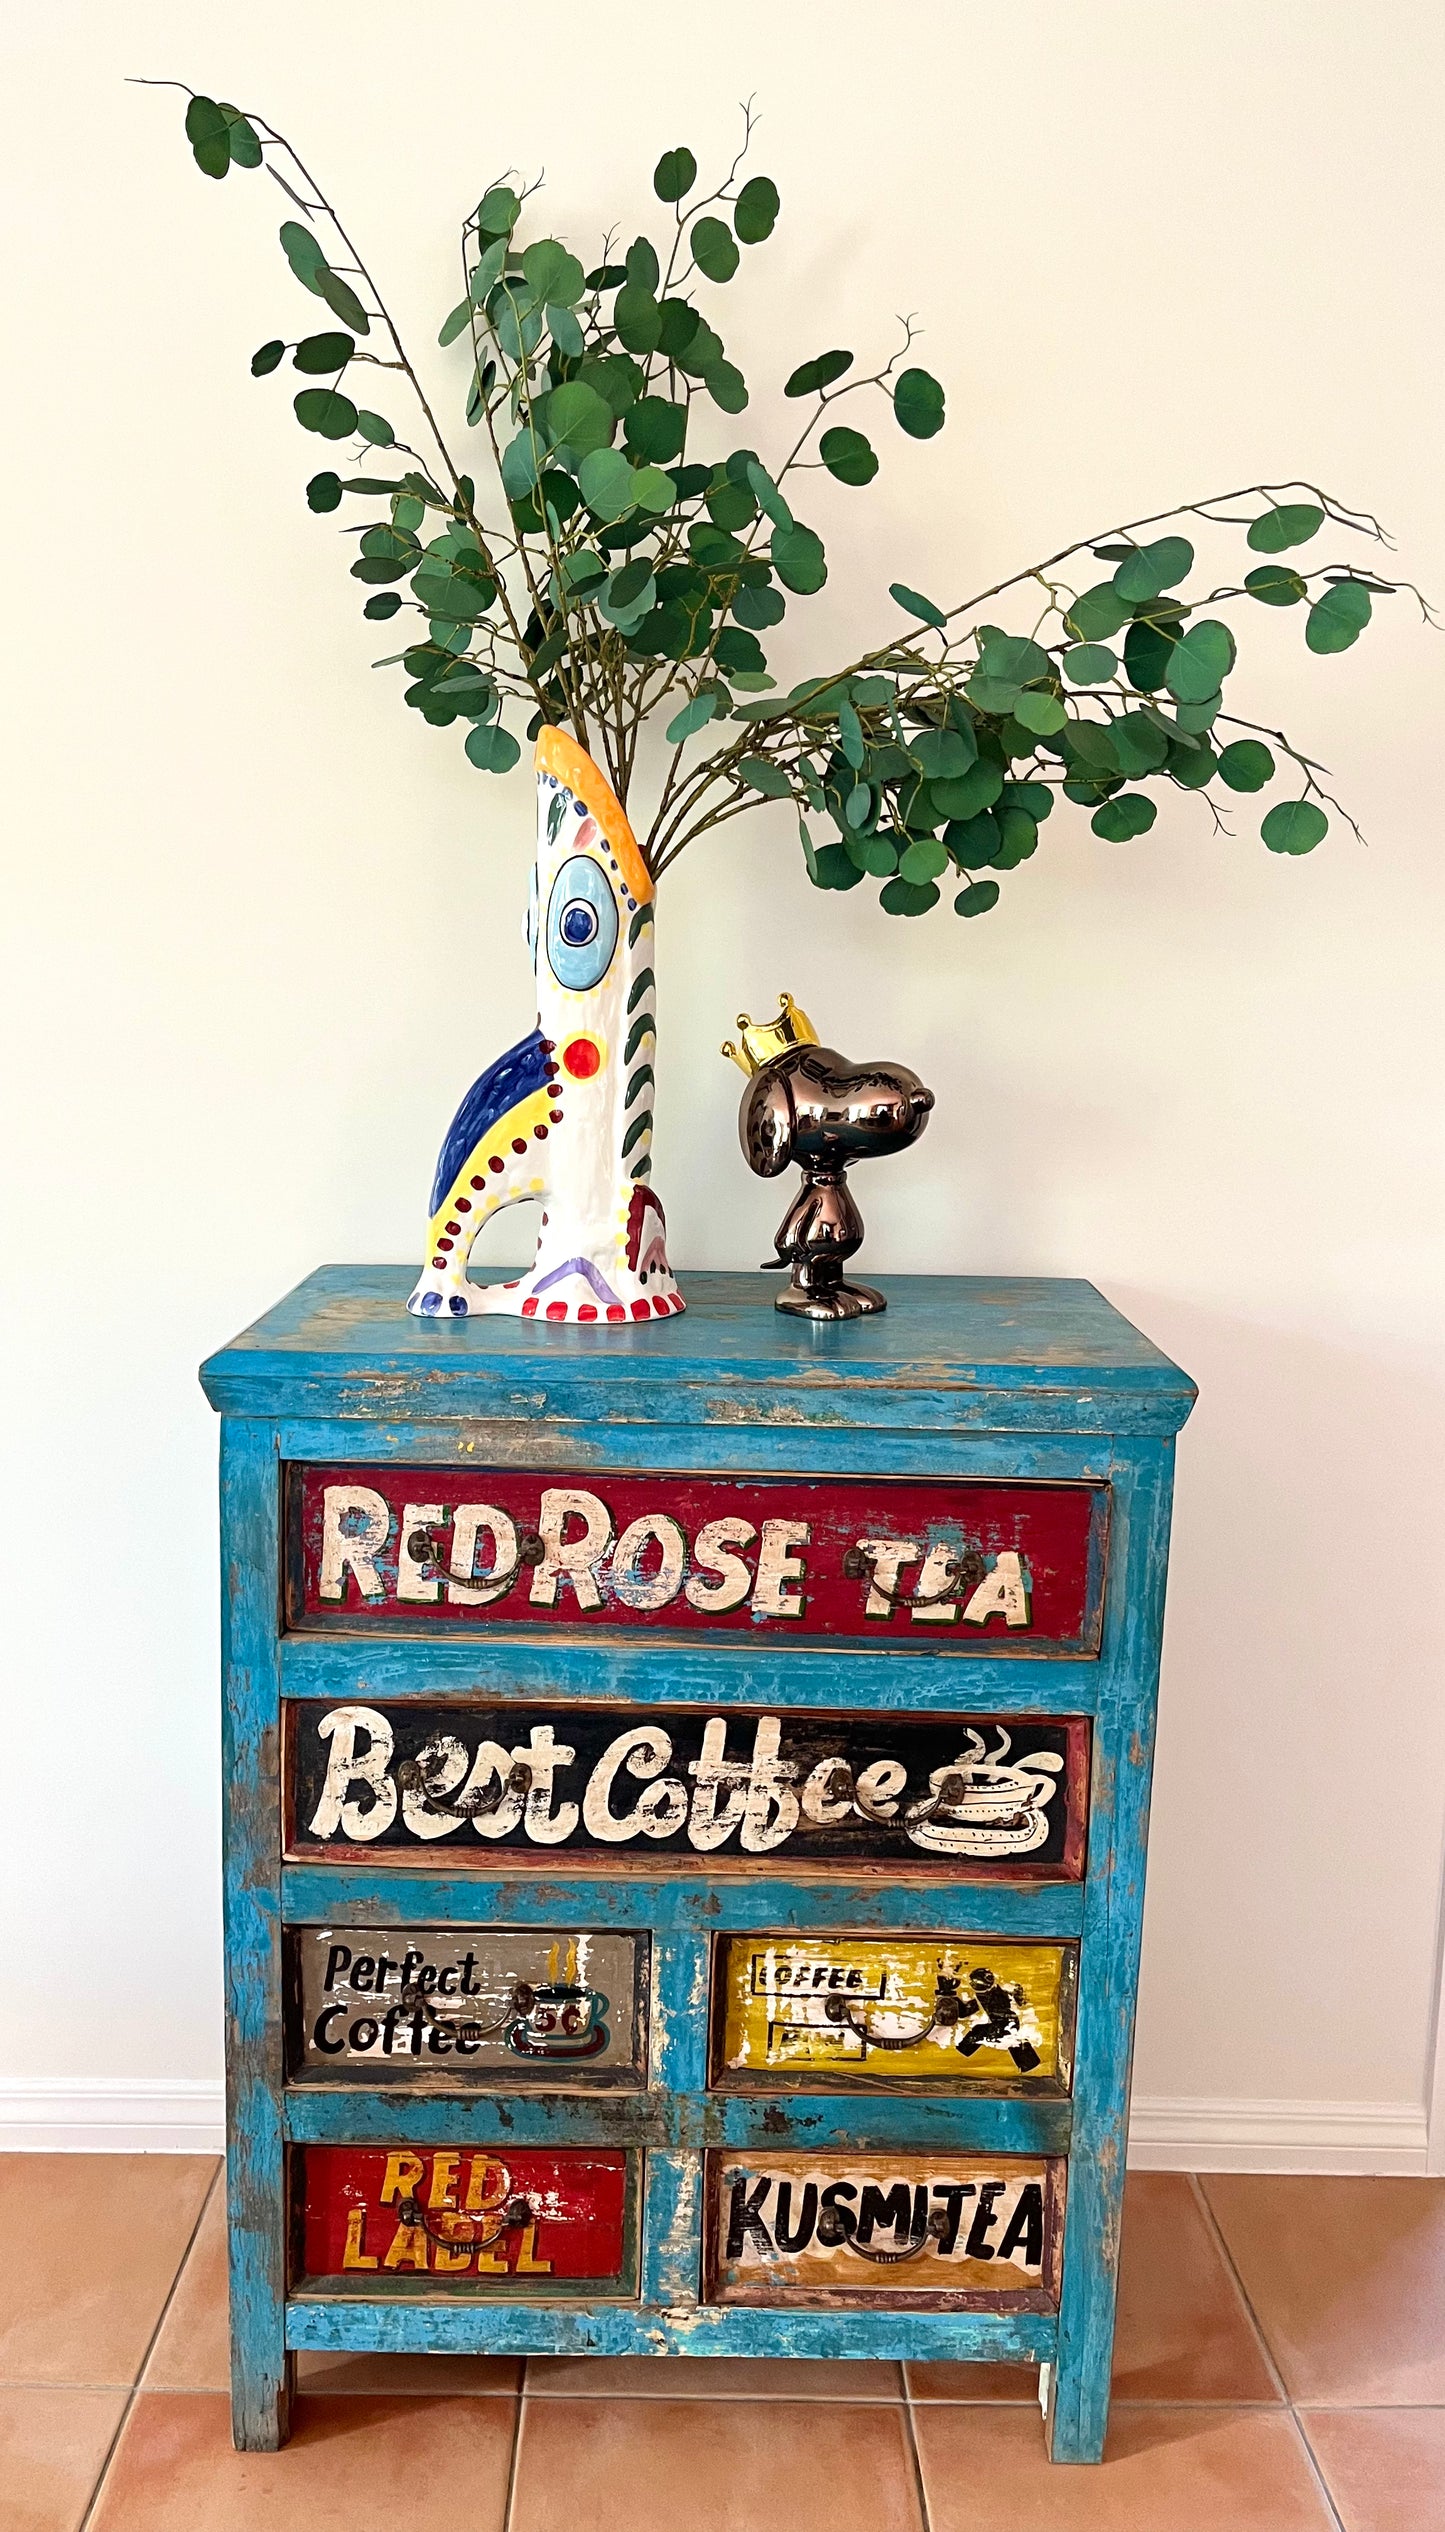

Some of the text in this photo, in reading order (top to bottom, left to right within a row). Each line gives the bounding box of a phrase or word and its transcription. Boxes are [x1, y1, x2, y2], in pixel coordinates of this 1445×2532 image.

[319, 1485, 1034, 1630] RED ROSE TEA
[308, 1705, 908, 1852] Best Coffee
[324, 1945, 482, 1995] Perfect
[314, 2004, 482, 2056] Coffee
[380, 2150, 511, 2210] RED
[342, 2208, 552, 2274] LABEL
